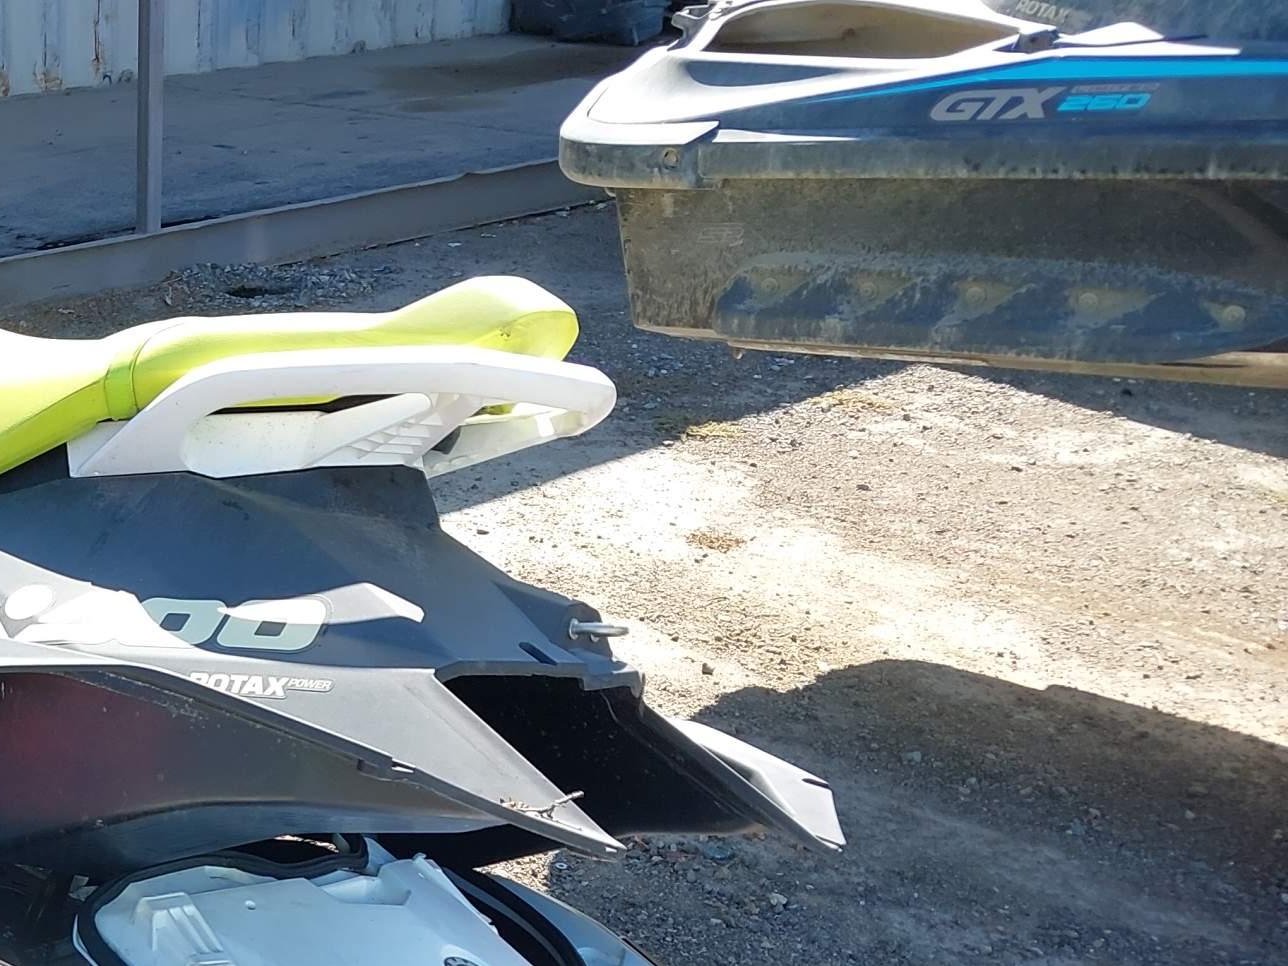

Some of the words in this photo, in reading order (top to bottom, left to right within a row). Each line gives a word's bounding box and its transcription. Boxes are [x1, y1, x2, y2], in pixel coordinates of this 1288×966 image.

[929, 86, 1067, 121] GTX
[1057, 92, 1152, 111] 260
[287, 678, 334, 690] POWER
